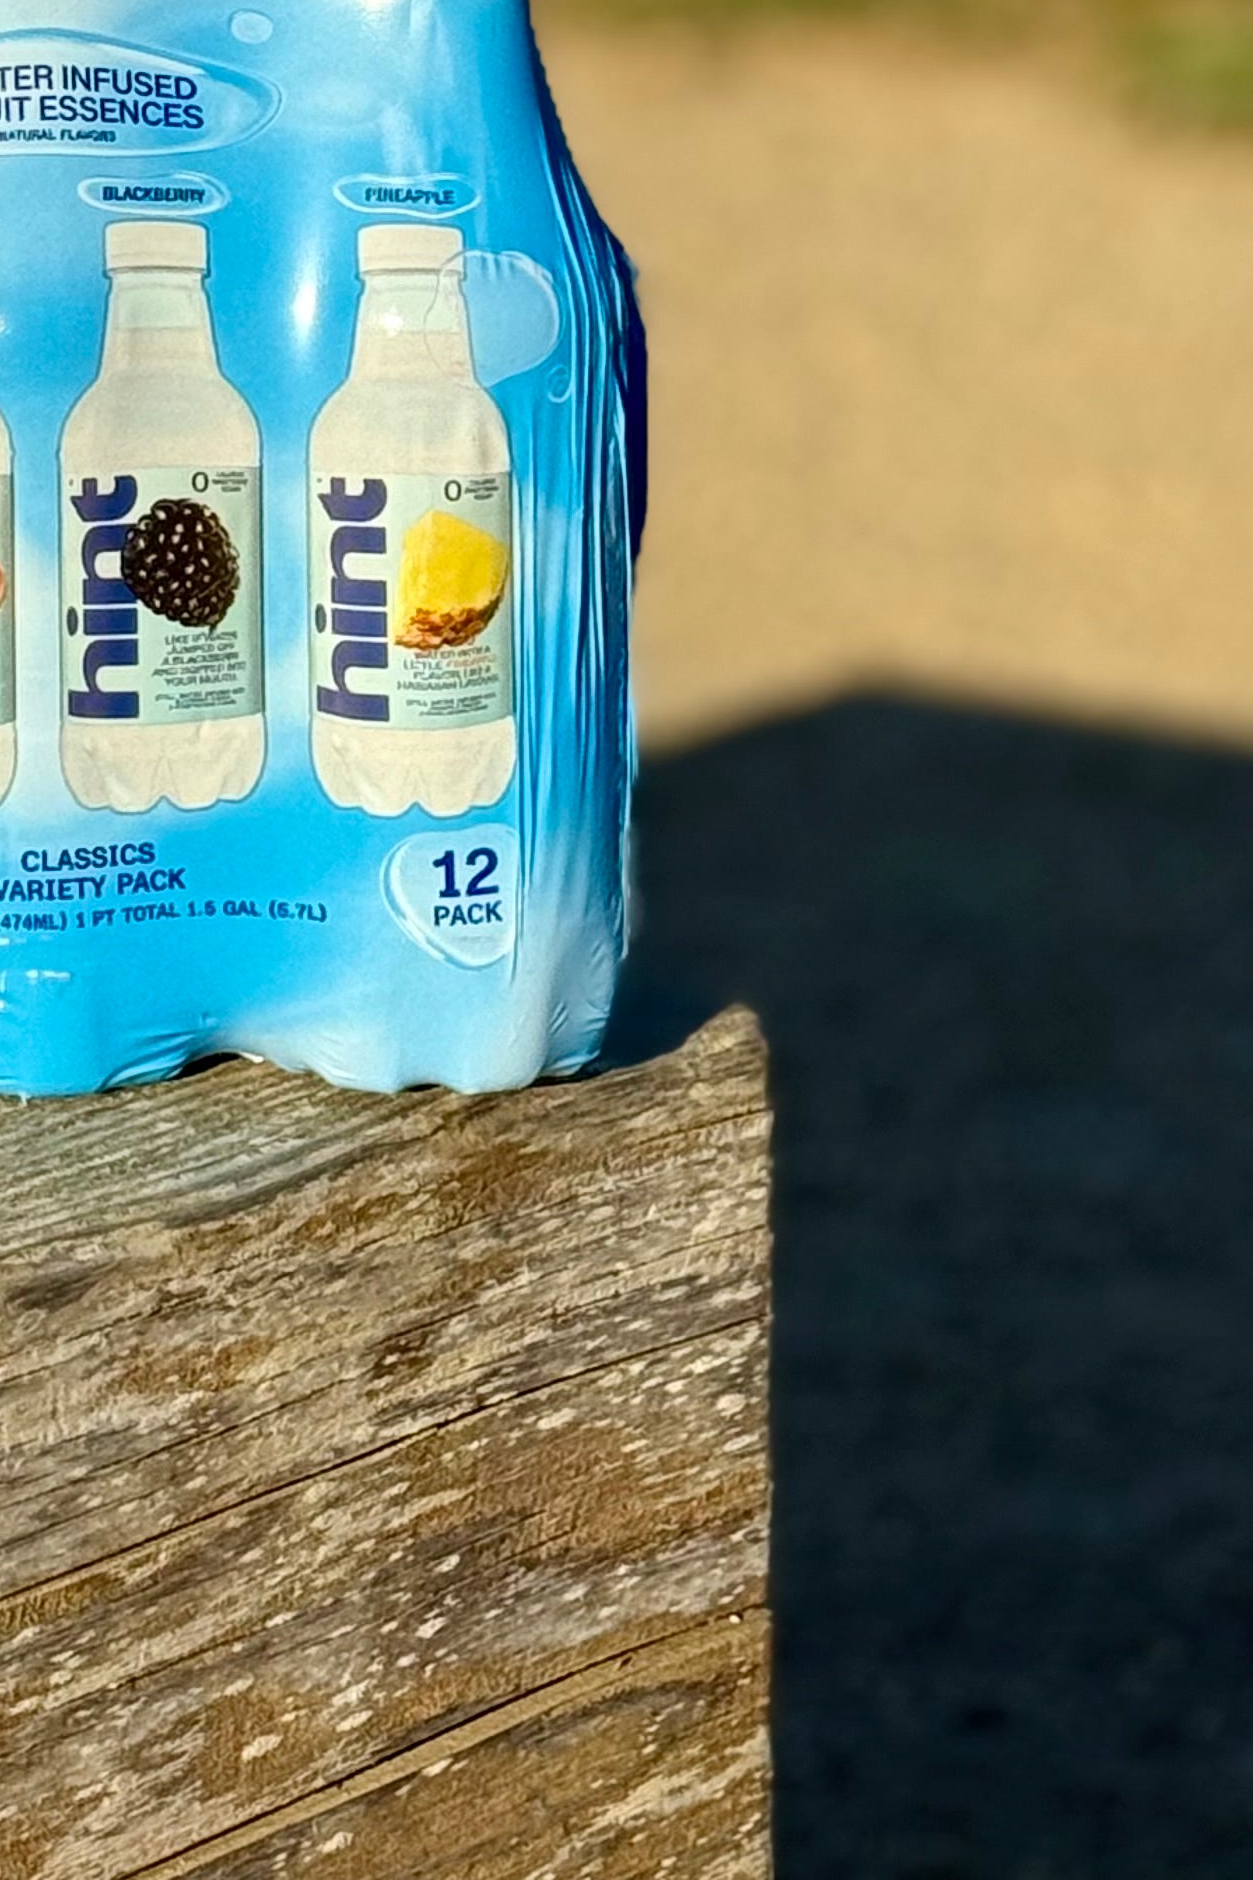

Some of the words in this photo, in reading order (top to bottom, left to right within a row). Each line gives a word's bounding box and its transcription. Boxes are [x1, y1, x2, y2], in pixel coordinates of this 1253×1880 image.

[62, 66, 197, 100] INFUSED
[39, 96, 205, 129] ESSENCES
[67, 475, 140, 719] hint
[315, 476, 390, 722] hint
[21, 842, 156, 872] CLASSICS
[432, 847, 500, 898] 12
[117, 868, 187, 895] PACK
[75, 912, 85, 929] 1
[92, 908, 115, 927] PT
[120, 901, 181, 924] TOTAL
[222, 900, 262, 918] GAL
[434, 900, 503, 927] PACK
